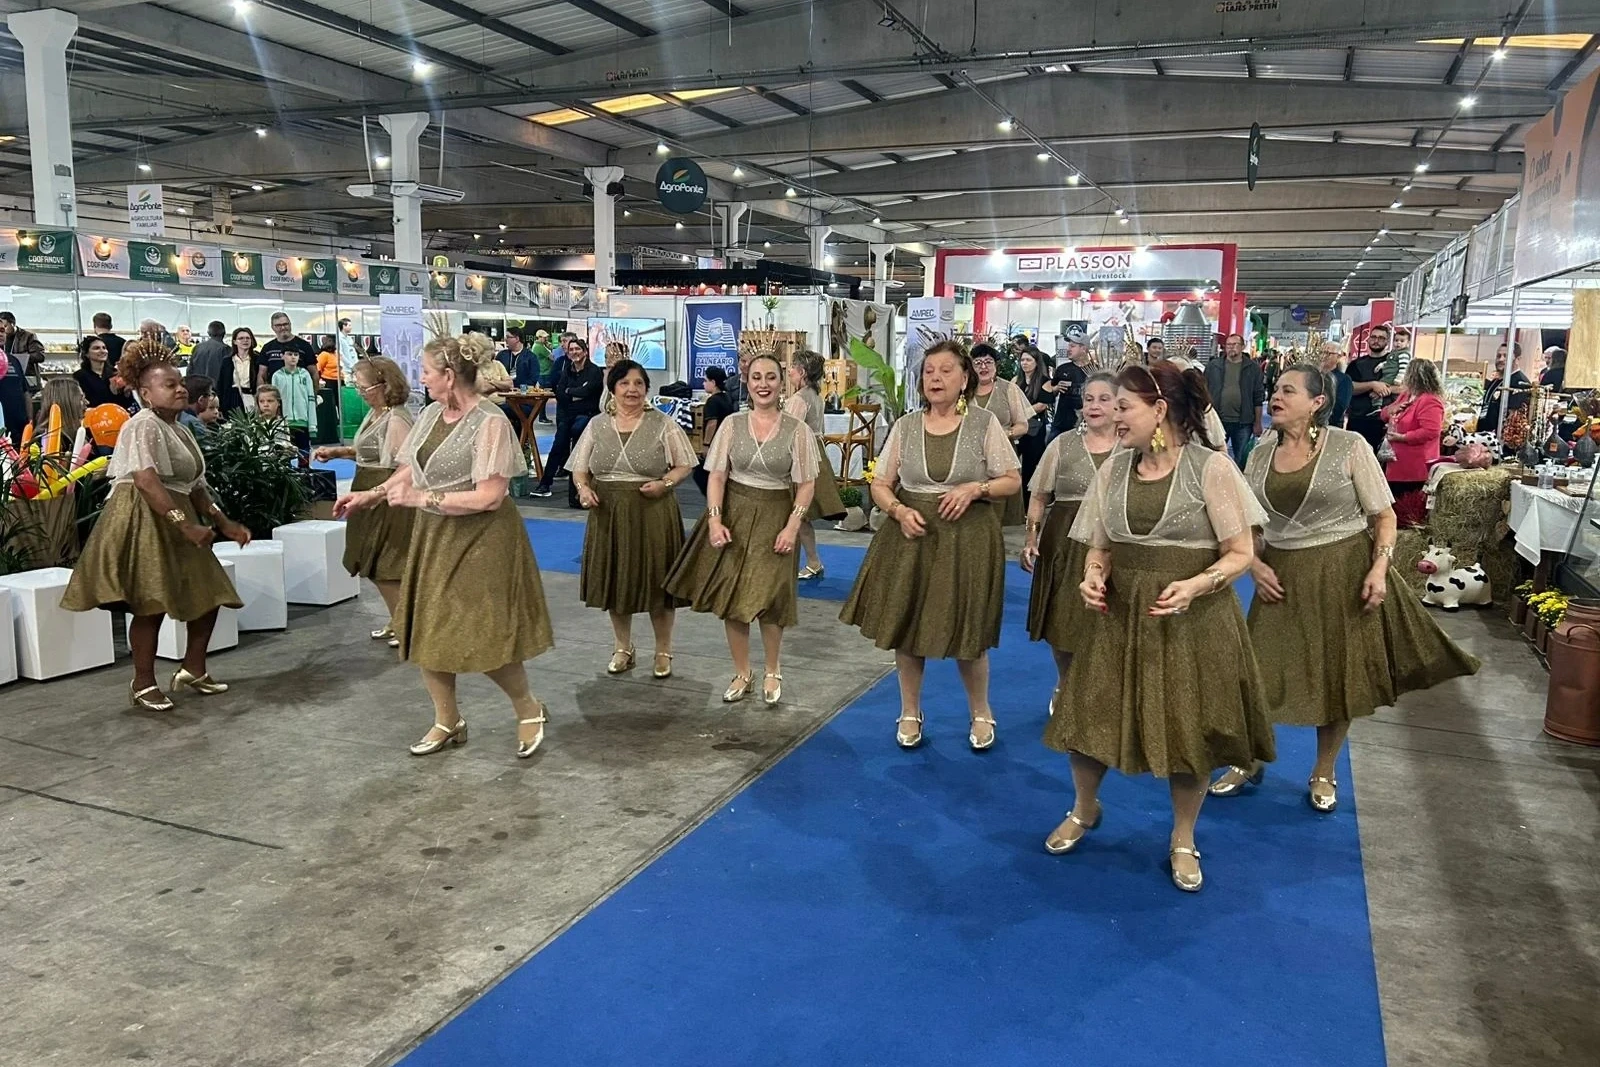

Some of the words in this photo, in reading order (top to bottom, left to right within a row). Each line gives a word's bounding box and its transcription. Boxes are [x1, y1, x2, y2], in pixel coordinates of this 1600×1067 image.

[659, 180, 704, 194] AgroPonte
[130, 202, 162, 212] AgroPonte
[28, 254, 64, 264] COOFANOVE
[1046, 254, 1131, 270] PLASSON
[87, 260, 119, 270] COOFANOVE
[140, 265, 170, 275] COOFANOVE
[186, 269, 214, 278] COOFANOVE
[1091, 271, 1127, 280] Livestock
[385, 305, 415, 314] AMREC
[911, 308, 935, 318] AMREC
